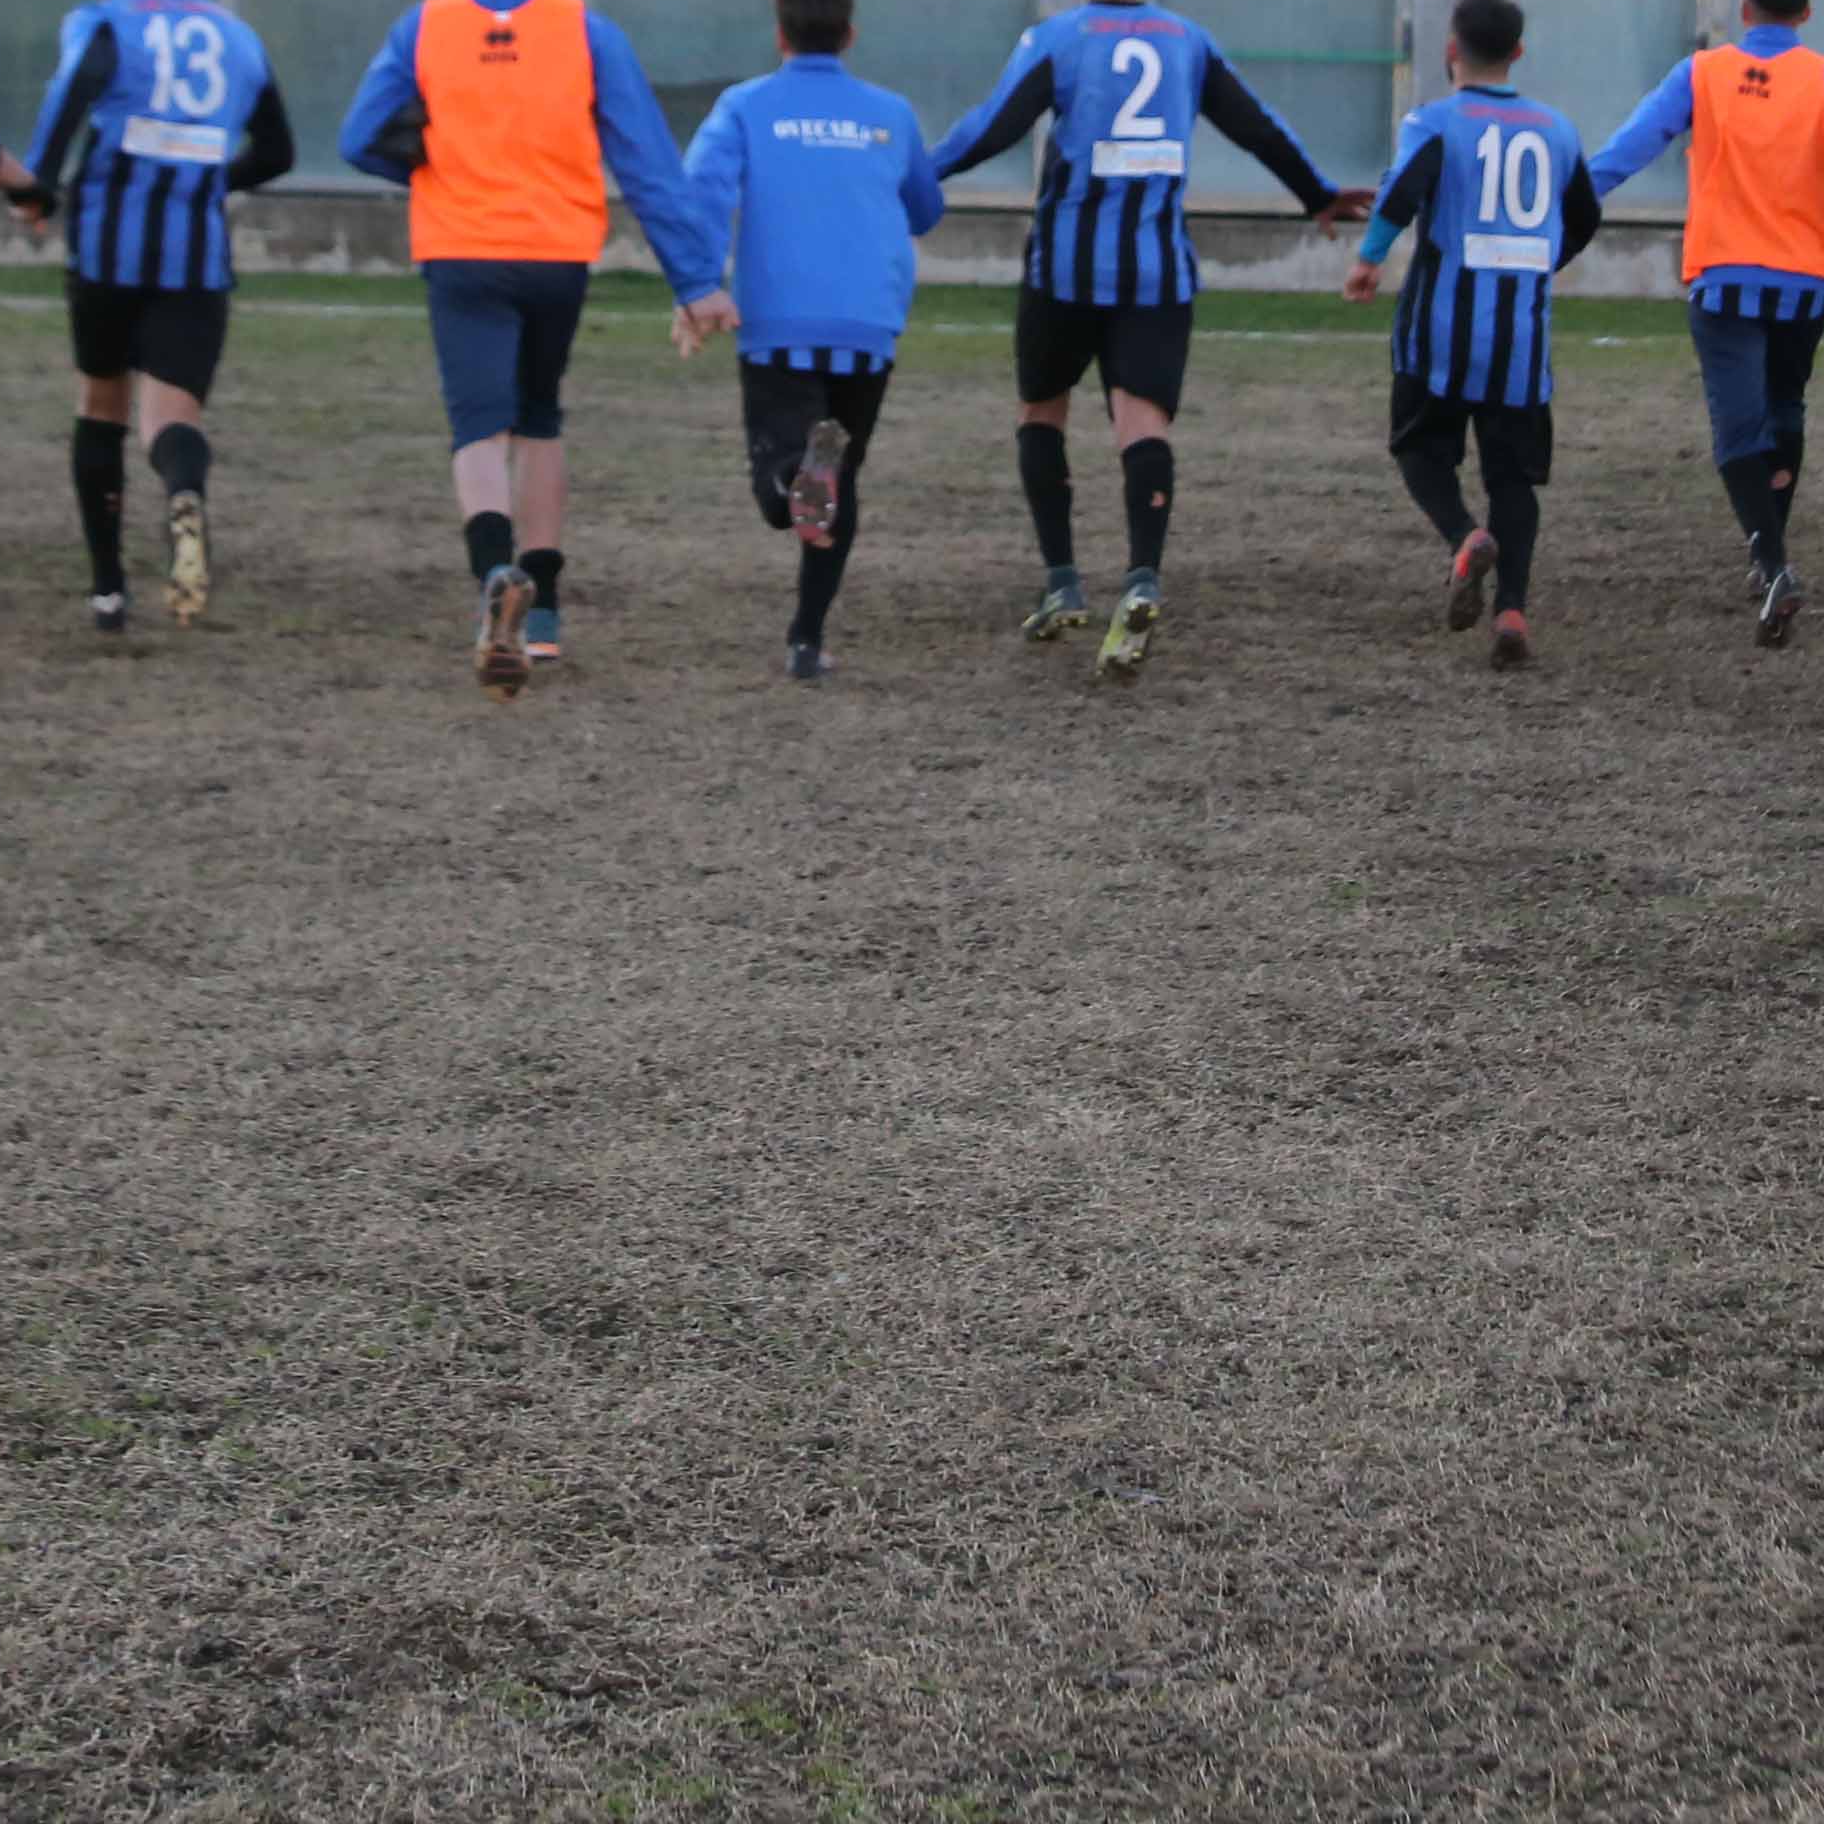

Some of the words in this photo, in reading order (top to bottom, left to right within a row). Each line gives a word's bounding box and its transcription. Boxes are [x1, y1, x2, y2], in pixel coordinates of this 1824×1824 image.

[143, 14, 226, 116] 13
[1110, 37, 1166, 137] 2
[1477, 123, 1553, 230] 10
